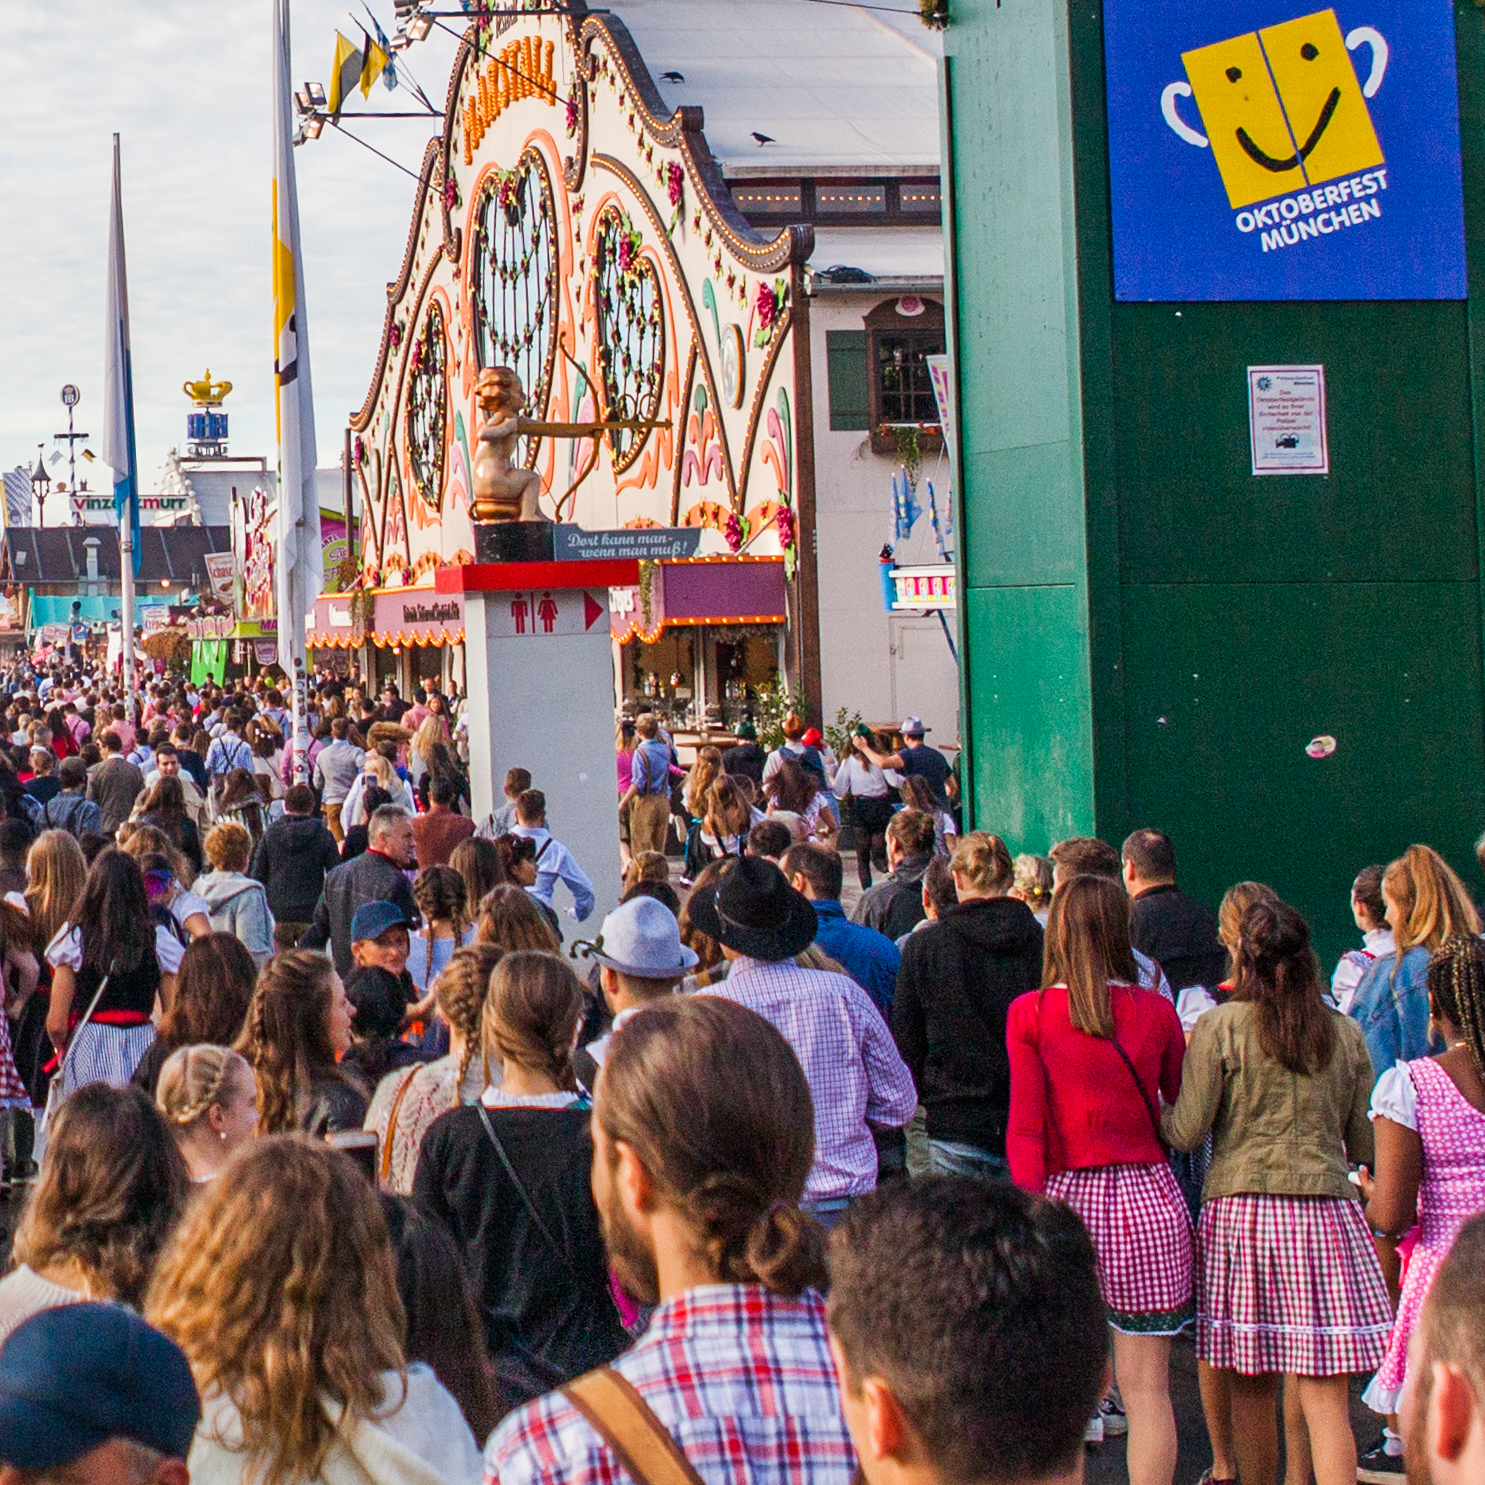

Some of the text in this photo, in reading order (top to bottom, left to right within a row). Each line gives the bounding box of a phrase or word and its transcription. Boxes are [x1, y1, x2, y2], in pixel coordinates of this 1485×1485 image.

[463, 35, 557, 166] MARSTALL
[1235, 169, 1389, 234] OKTOBERFEST
[1260, 198, 1381, 253] MÜNCHEN
[568, 533, 598, 547] Dort
[601, 532, 635, 546] kann
[618, 546, 648, 557] man
[650, 540, 688, 559] muß!
